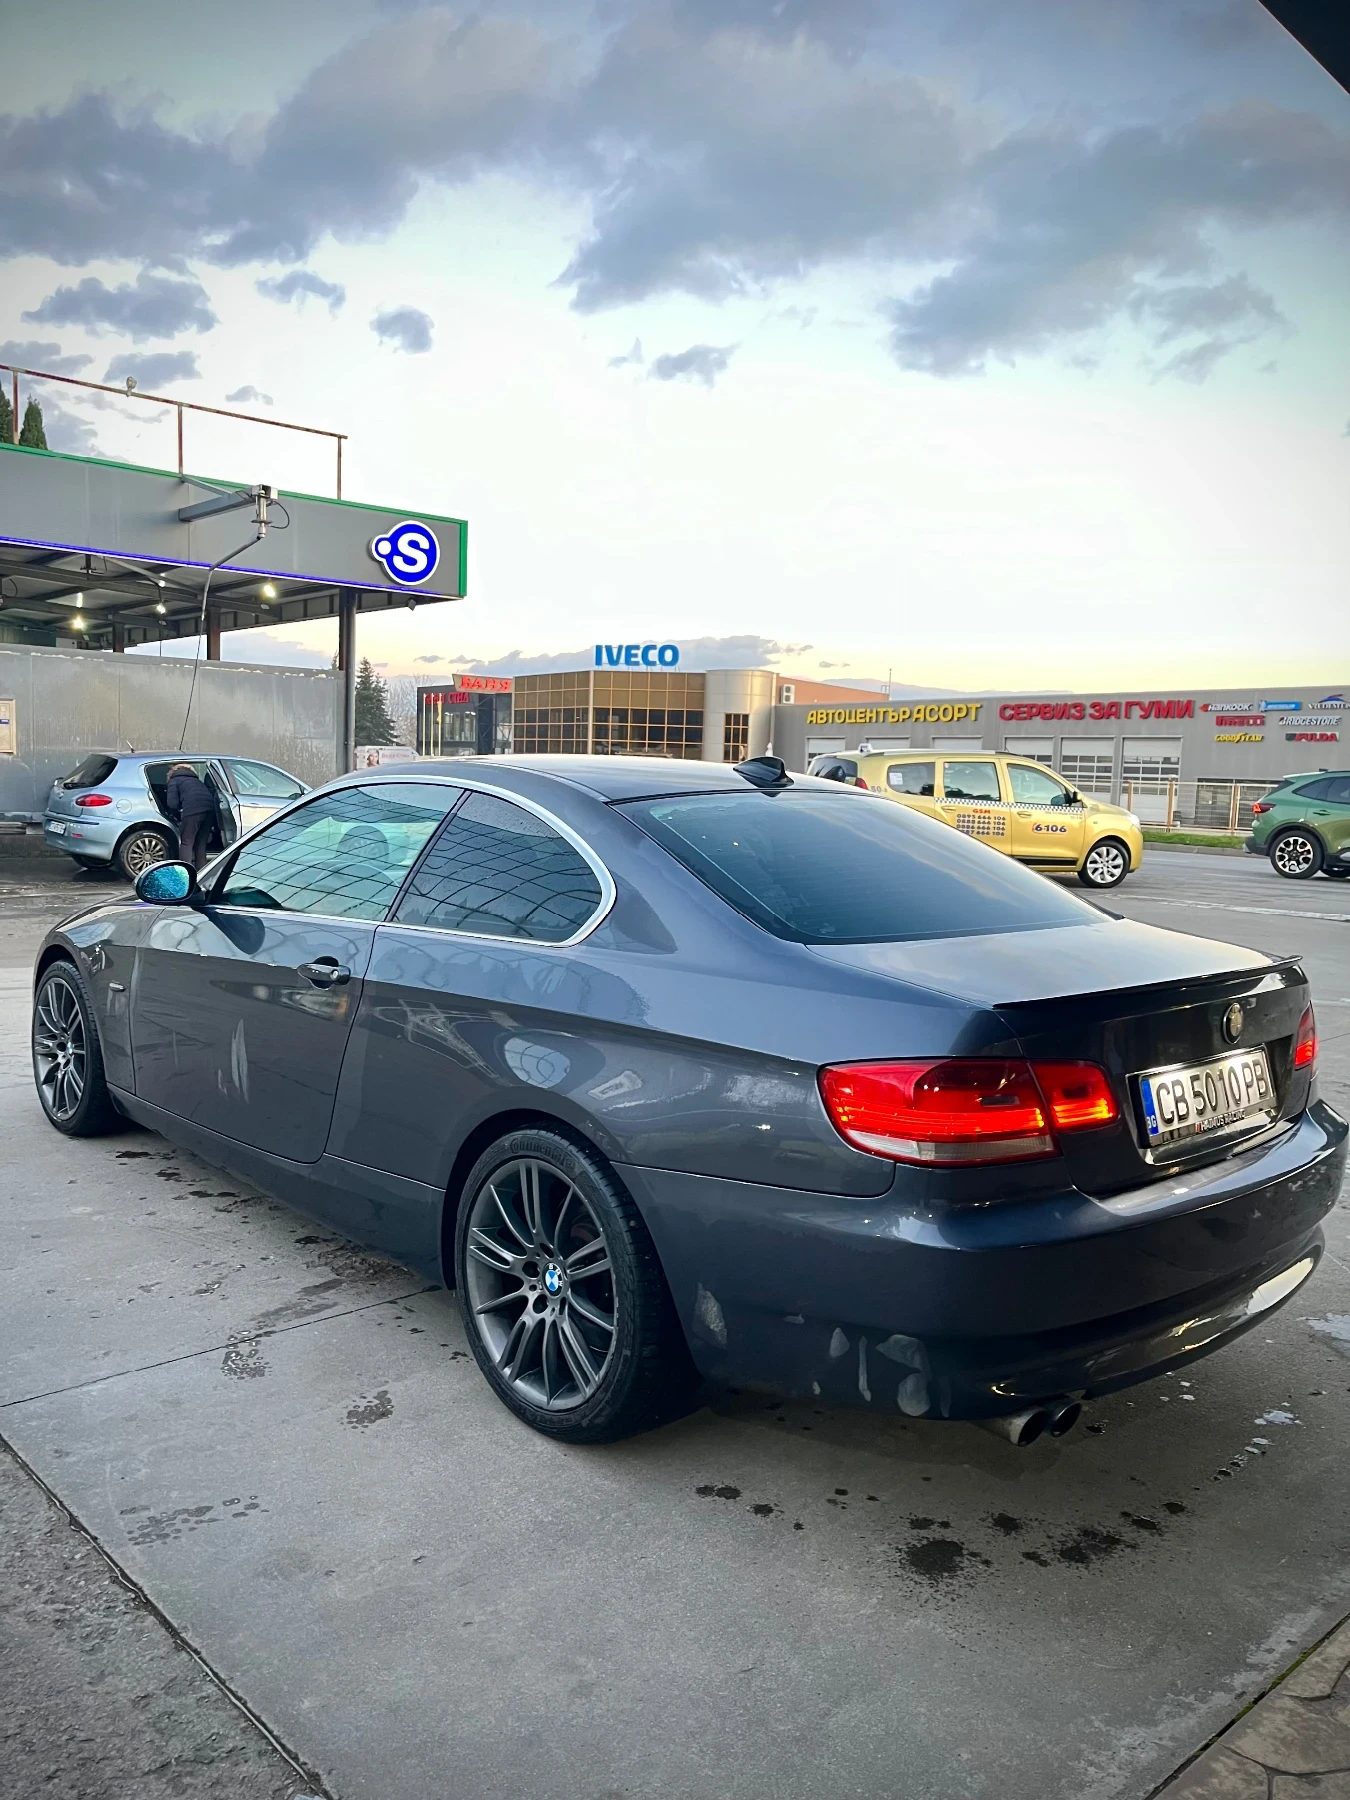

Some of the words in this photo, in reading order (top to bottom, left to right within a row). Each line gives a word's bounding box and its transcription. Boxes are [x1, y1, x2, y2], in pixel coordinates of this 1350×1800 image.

[392, 532, 430, 574] S
[595, 645, 679, 666] IVECO
[460, 677, 512, 692] БАНЯ
[807, 707, 911, 724] АВТОЦЕНТЪР
[912, 703, 982, 722] АСОРТ
[999, 702, 1085, 721] СЕРВИЗ
[1088, 701, 1122, 720] ЗА
[1124, 699, 1194, 720] ГУМИ
[1294, 732, 1339, 742] FULDA
[1156, 1079, 1190, 1125] CB
[1190, 1066, 1241, 1115] 5010
[1241, 1058, 1268, 1104] PB
[1146, 1116, 1157, 1129] BG
[510, 1138, 567, 1166] Continental
